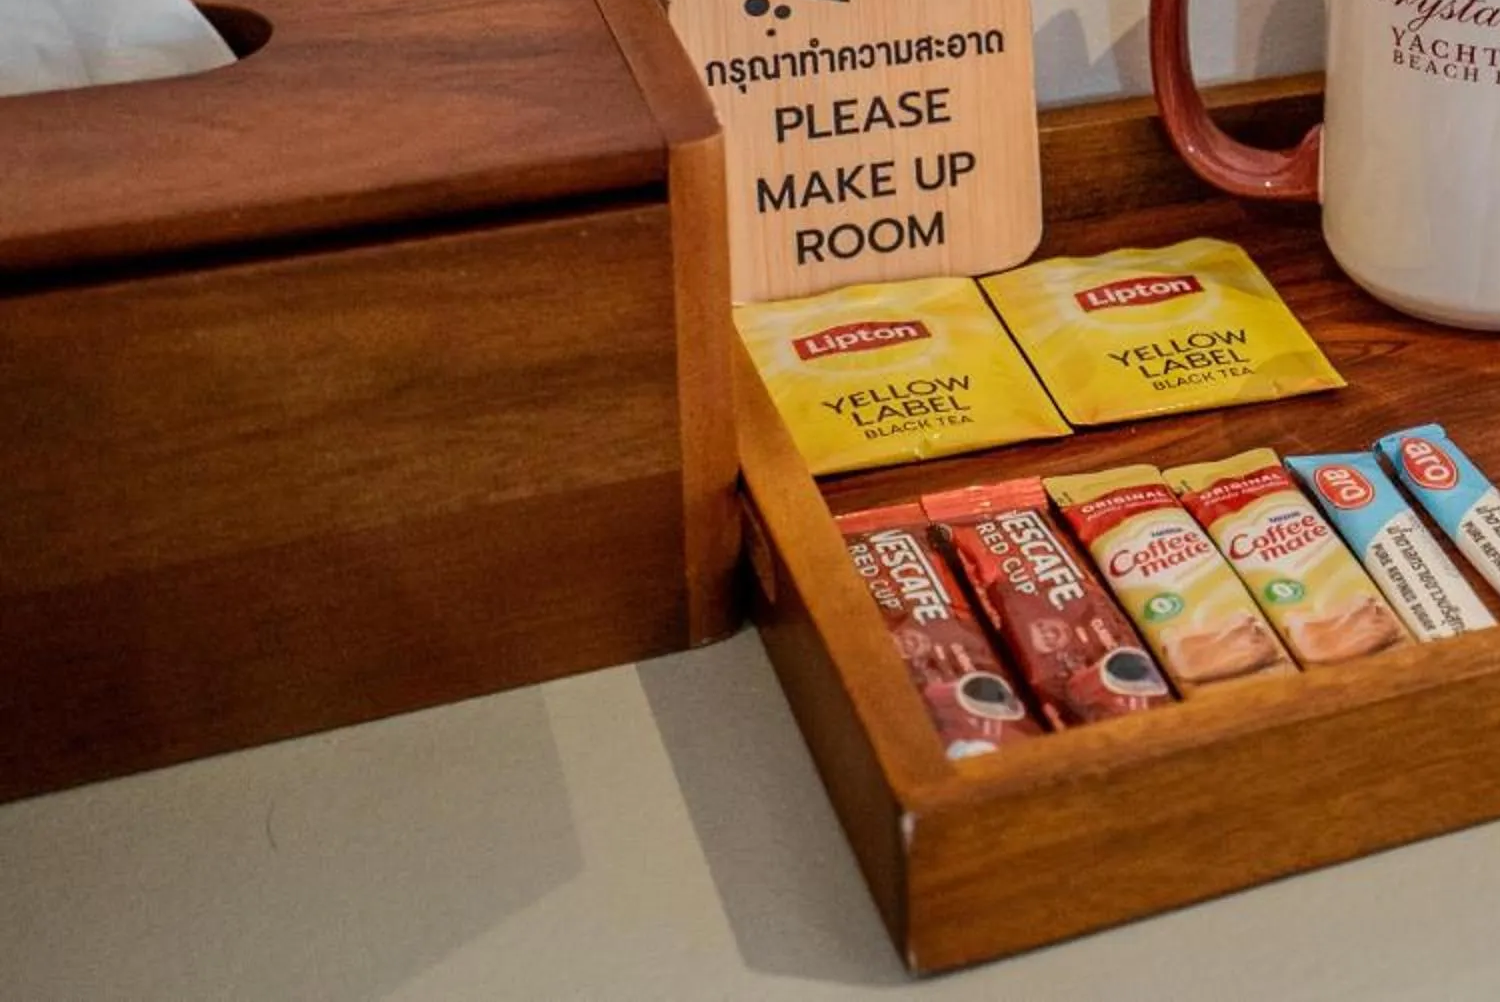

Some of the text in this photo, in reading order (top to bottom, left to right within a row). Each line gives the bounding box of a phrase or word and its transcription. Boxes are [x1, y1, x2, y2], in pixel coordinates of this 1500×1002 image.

[705, 28, 1004, 93] กรุณาทำความสะอาด
[1393, 49, 1480, 83] BEACH
[775, 88, 951, 143] PLEASE
[757, 151, 976, 213] MAKE UP
[796, 211, 945, 265] ROOM
[1086, 278, 1192, 306] Lipton
[805, 324, 918, 355] Lipton
[1108, 329, 1247, 367] YELLOW
[1138, 348, 1250, 379] LABEL
[1152, 365, 1254, 391] BLACK TEA
[822, 375, 970, 415] YELLOW
[851, 395, 971, 427] LABEL
[864, 414, 974, 440] BLACK TEA
[1405, 442, 1450, 480] aro
[1323, 468, 1366, 502] aro
[1109, 531, 1199, 578] Coffee
[1229, 514, 1316, 560] Coffee
[1259, 524, 1329, 562] mate
[848, 543, 902, 611] RED CUP
[976, 522, 1038, 596] RED CUP
[1140, 541, 1211, 578] mate
